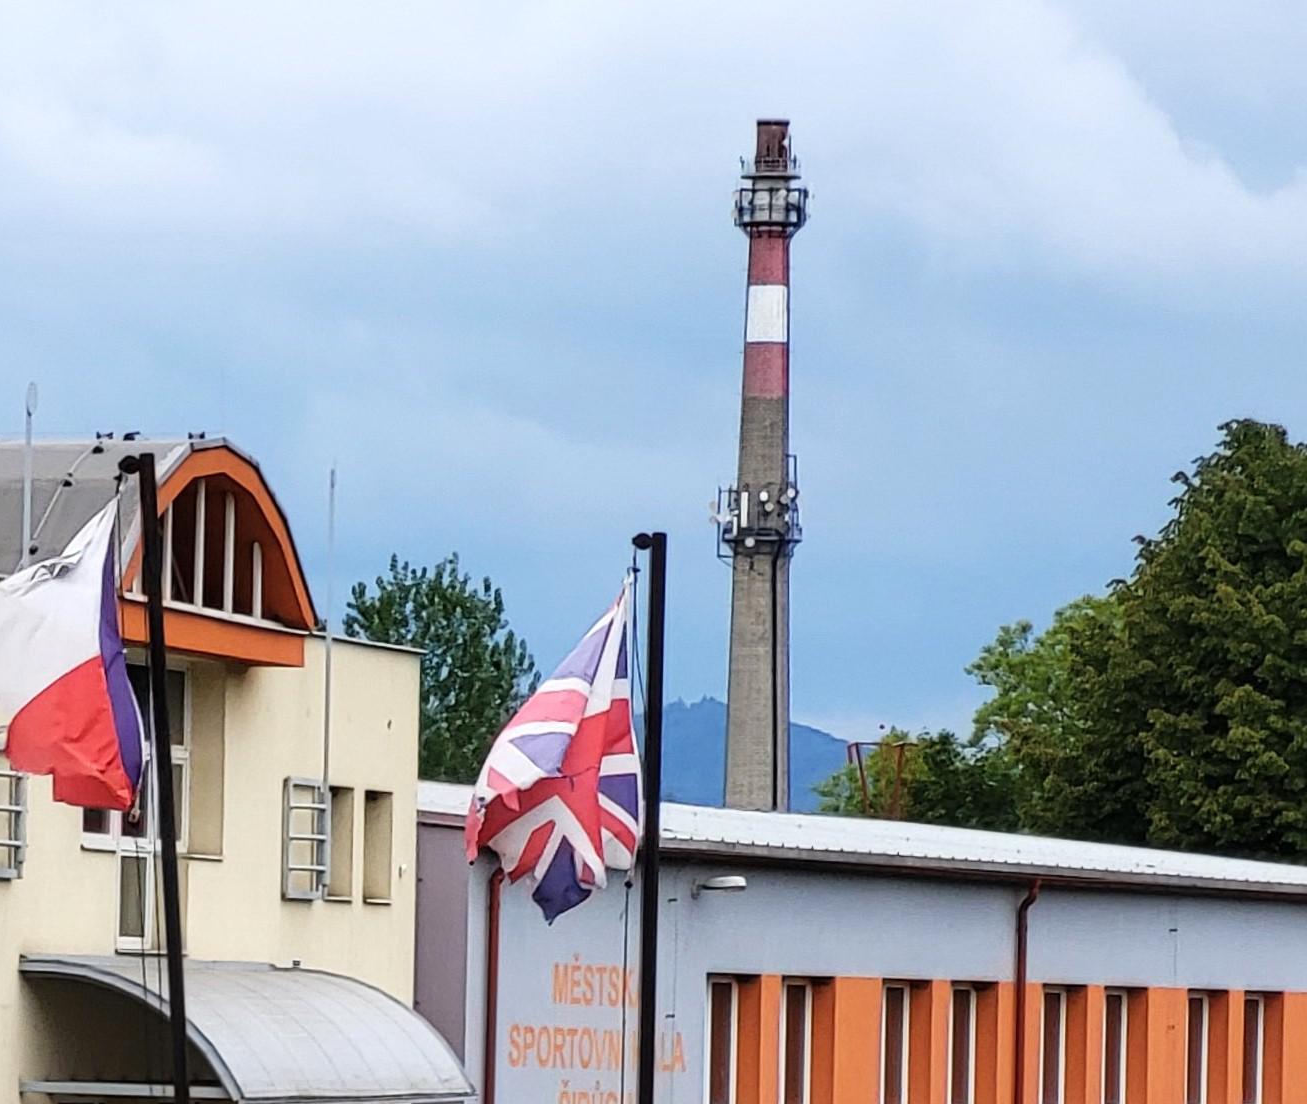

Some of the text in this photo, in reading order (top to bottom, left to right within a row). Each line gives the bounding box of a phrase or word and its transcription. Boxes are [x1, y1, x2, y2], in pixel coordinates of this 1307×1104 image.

[552, 953, 641, 1007] MĚSTSK
[507, 1024, 687, 1072] SPORTOVN HLA
